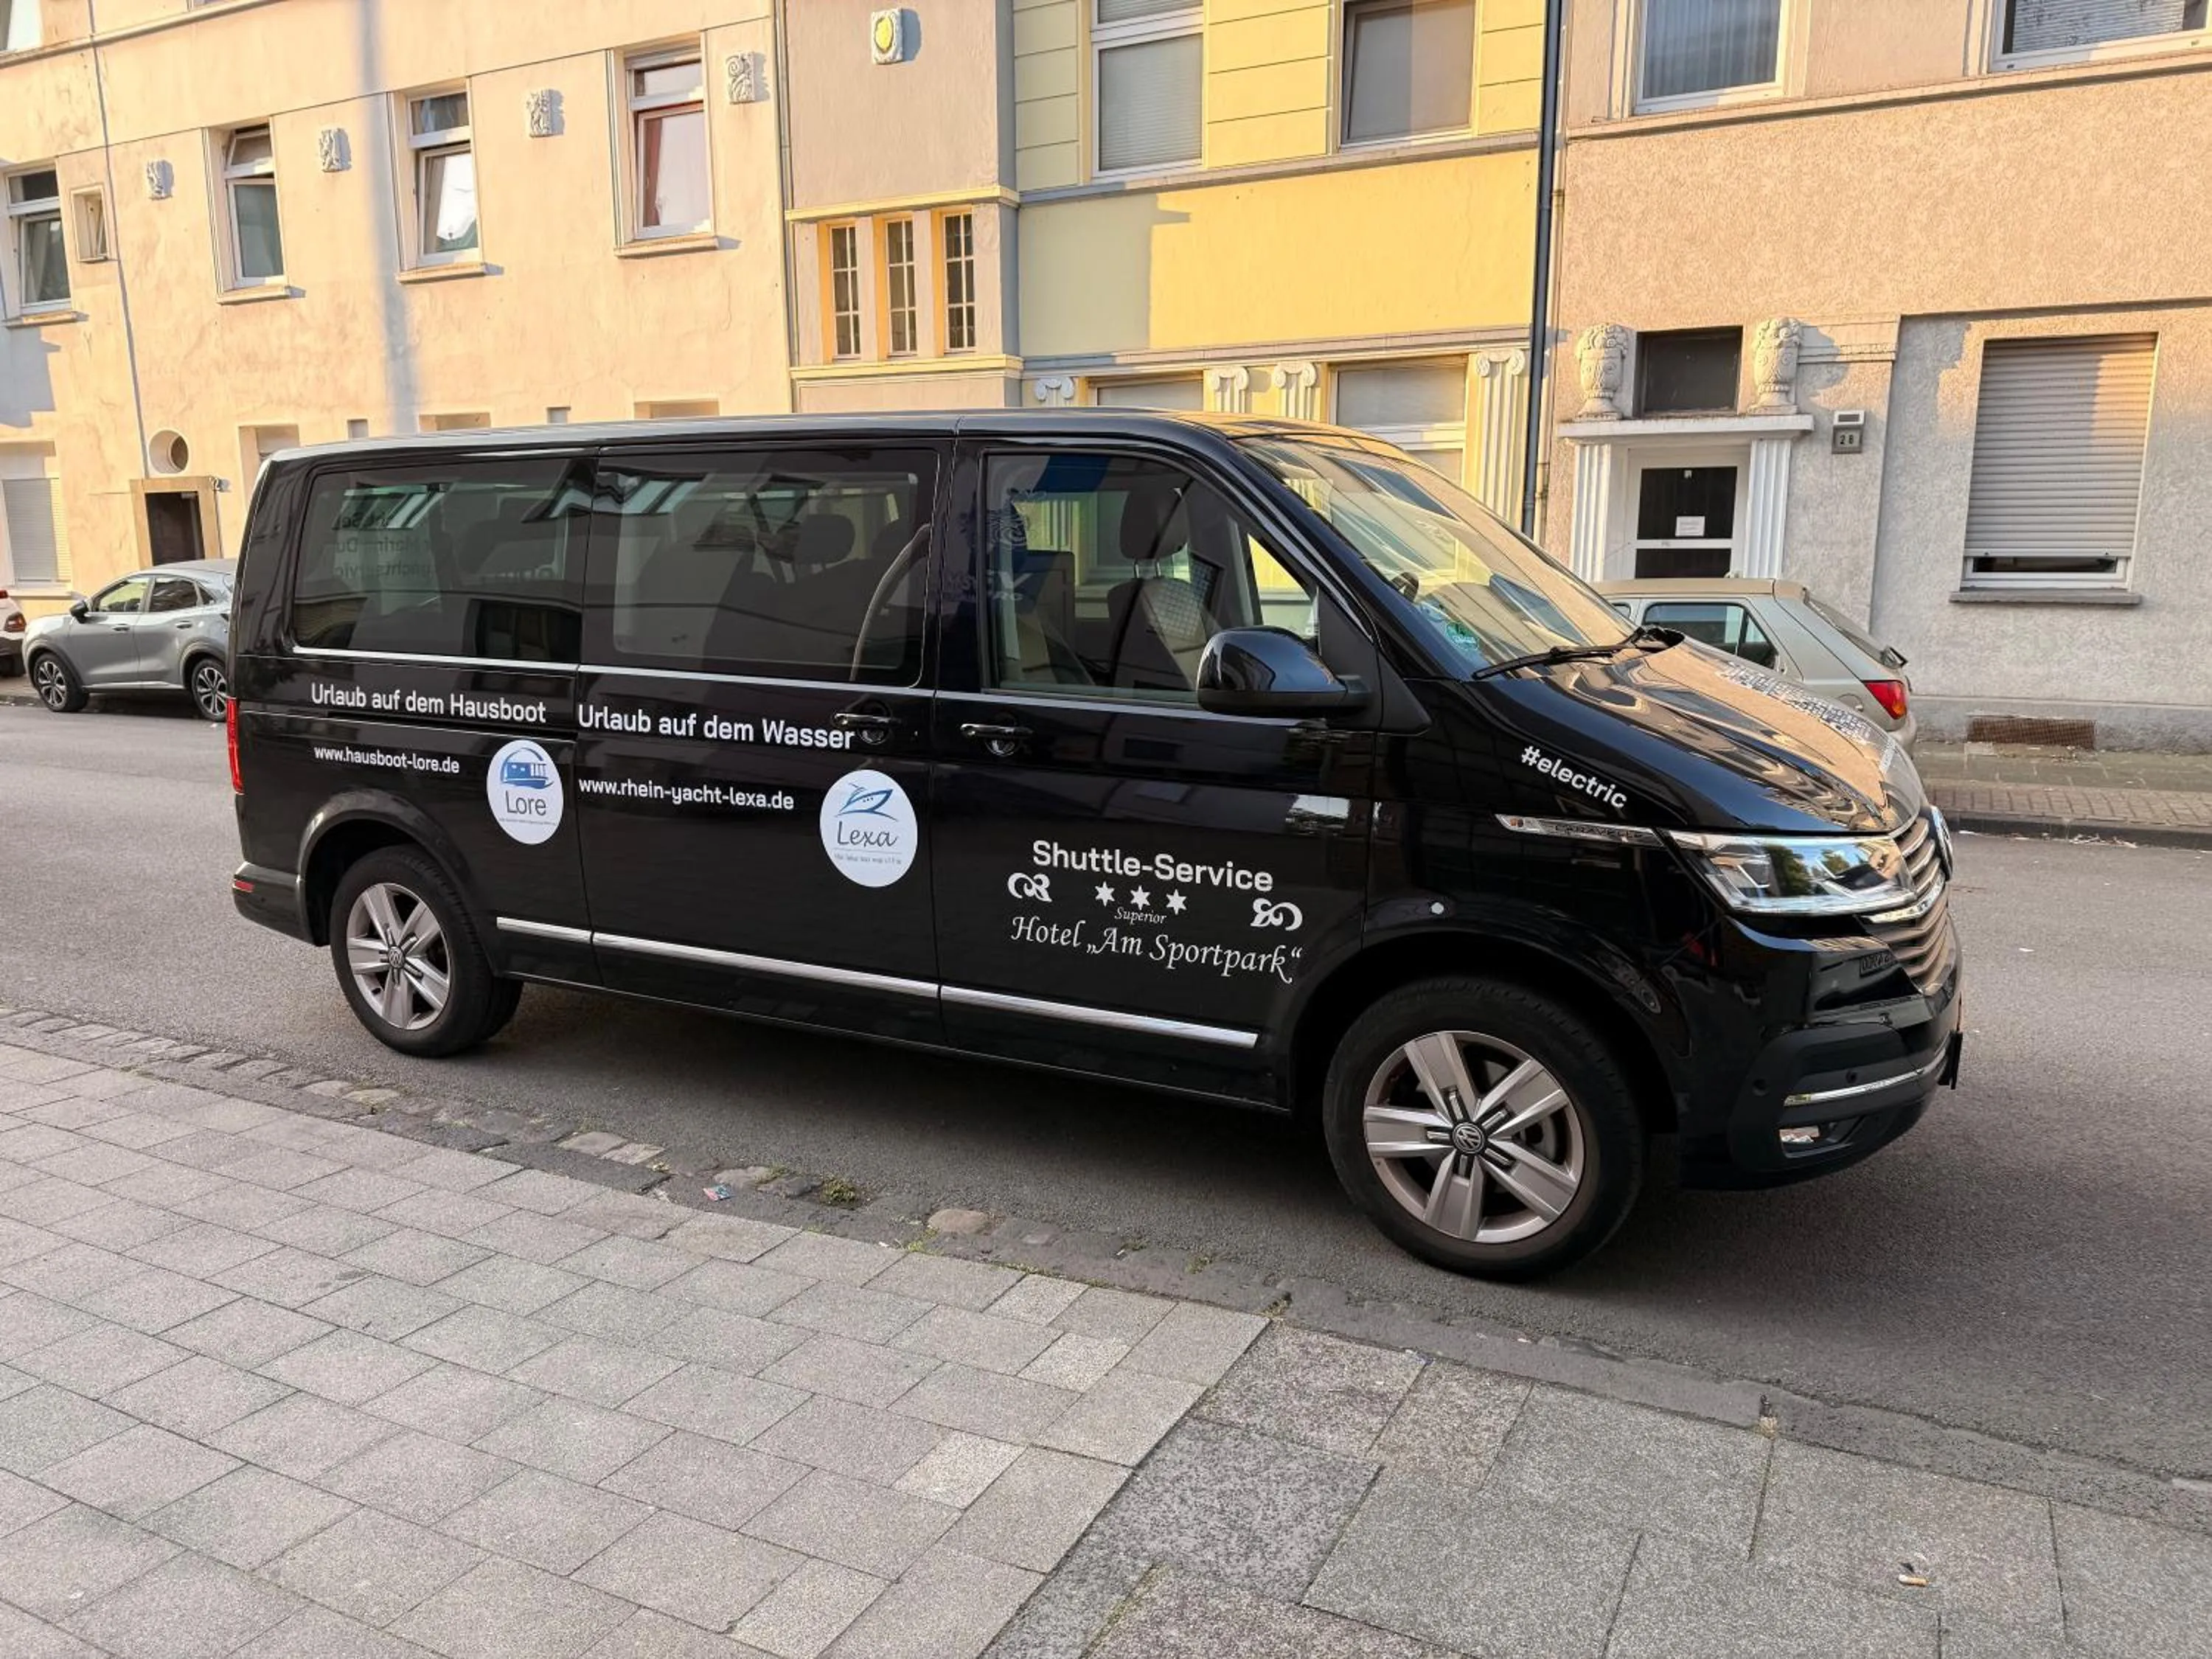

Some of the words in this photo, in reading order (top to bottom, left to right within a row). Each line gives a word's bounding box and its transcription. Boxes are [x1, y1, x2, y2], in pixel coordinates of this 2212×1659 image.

[311, 683, 367, 708] Urlaub
[371, 689, 400, 712] auf
[405, 690, 444, 715] dem
[450, 694, 547, 723] Hausboot
[578, 703, 651, 732] Urlaub
[658, 712, 698, 737] auf
[703, 714, 754, 742] dem
[762, 719, 856, 749] Wasser
[313, 745, 460, 773] www.hausboot-lore.de
[1520, 745, 1627, 807] #electric
[505, 790, 547, 816] Lore
[578, 778, 794, 810] www.rhein-yacht-lexa.de
[837, 821, 898, 847] Lexa
[1032, 840, 1273, 891] Shuttle-Service
[1010, 916, 1087, 947] Hotel
[1114, 907, 1167, 926] Superior
